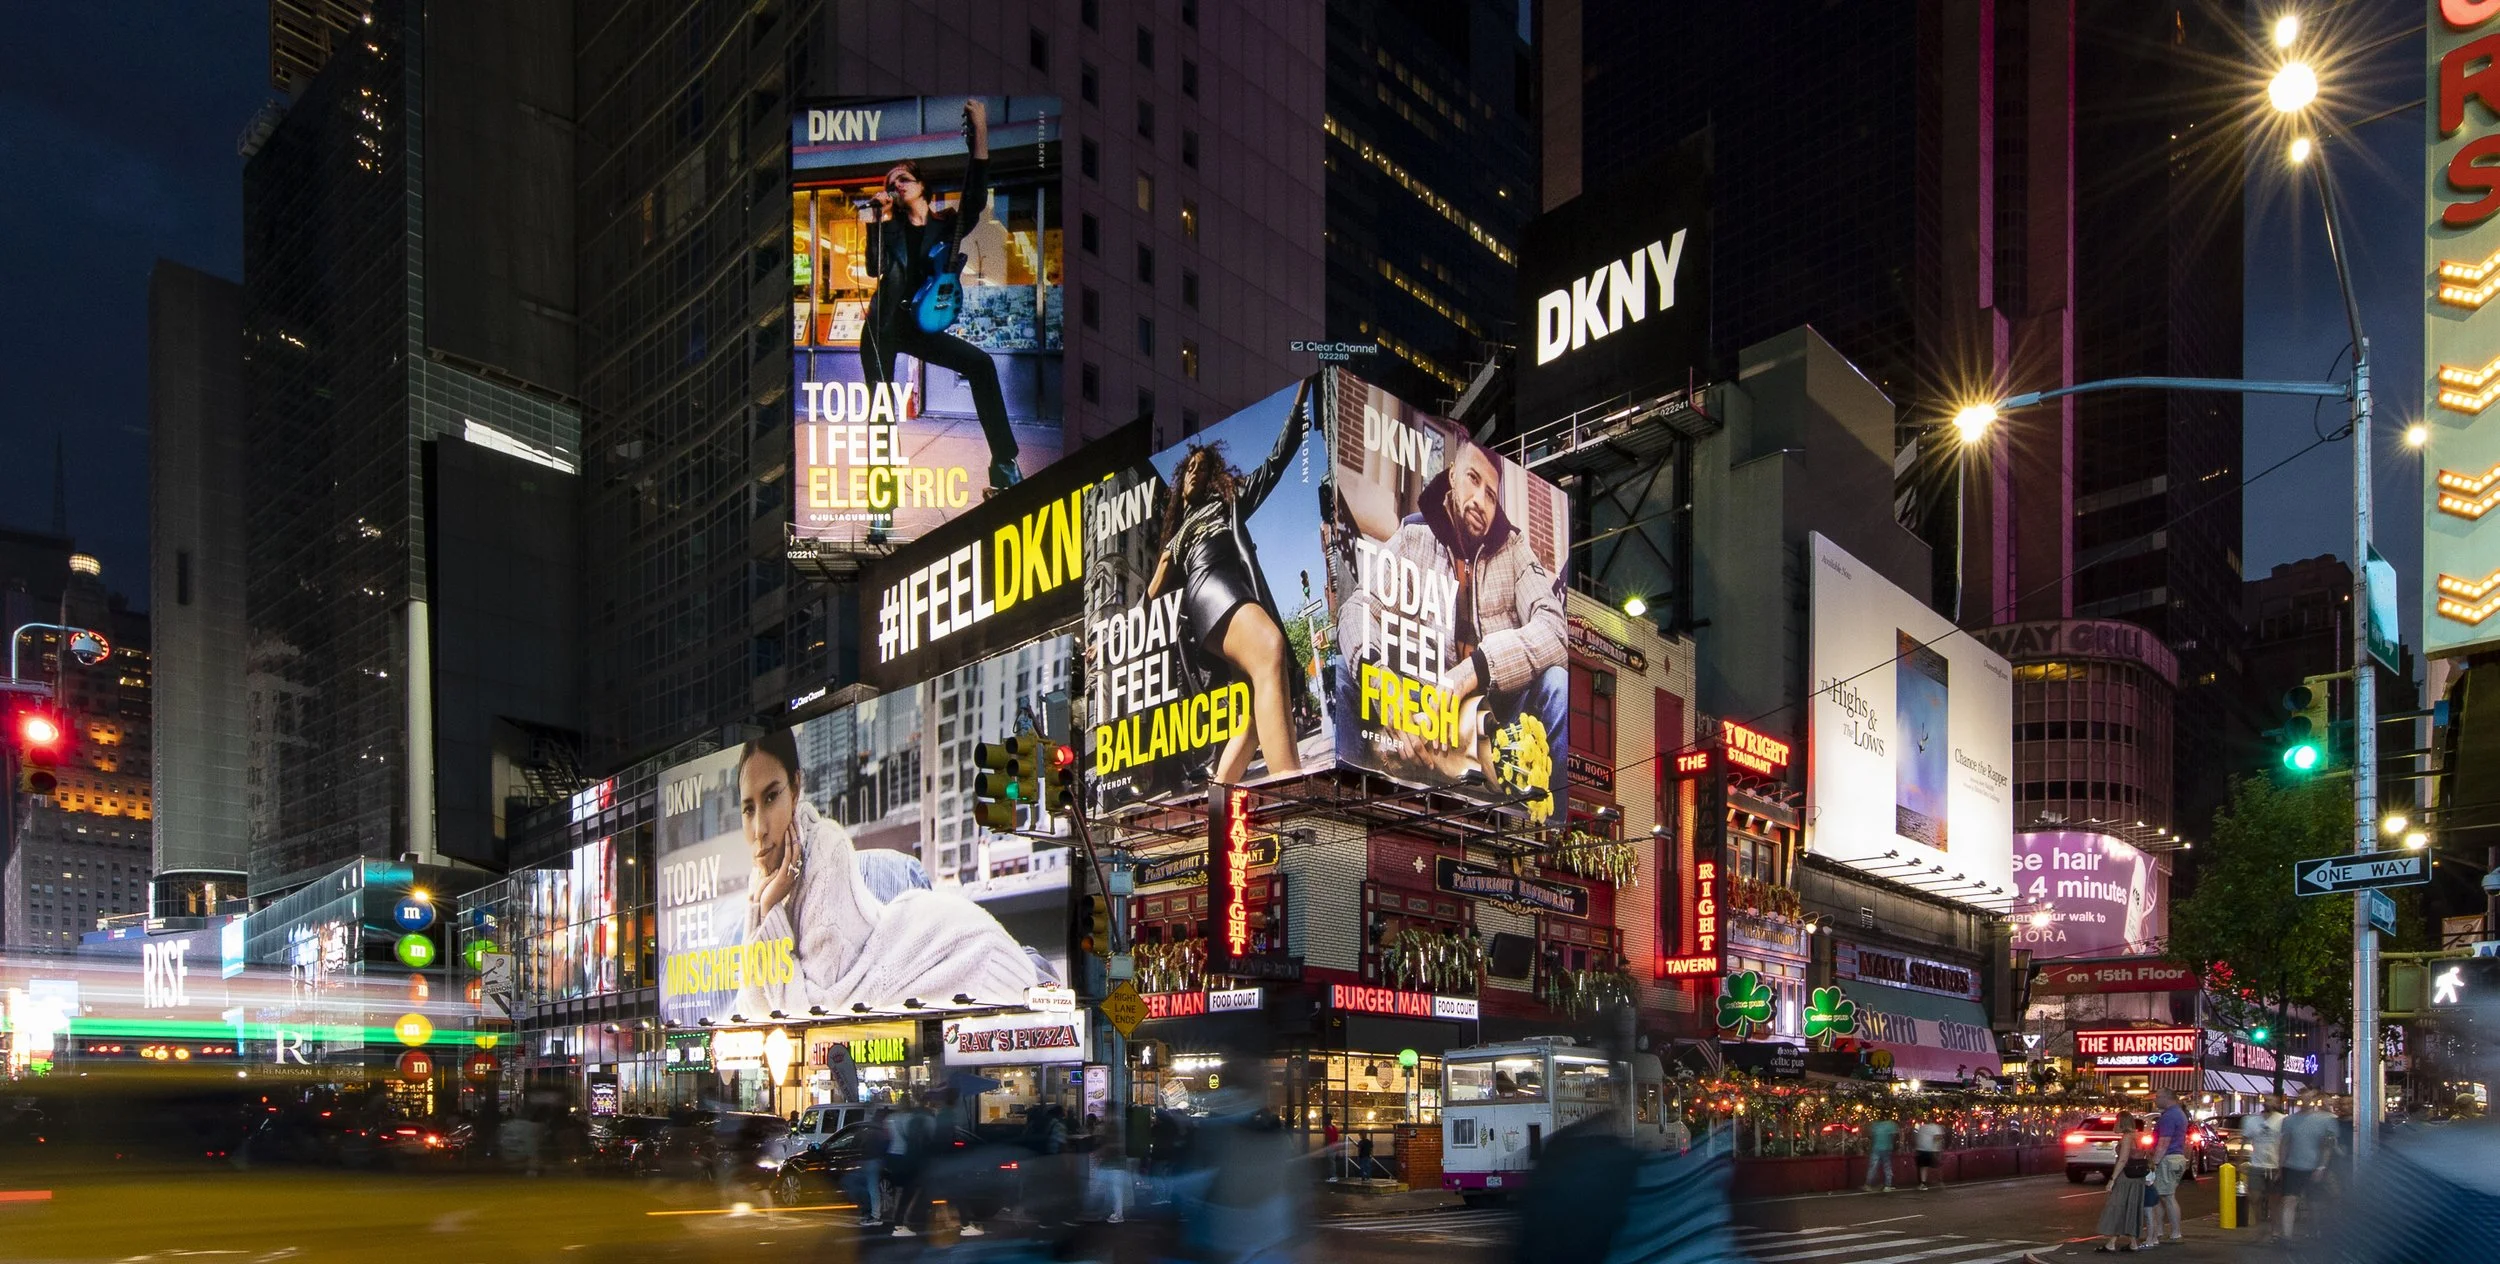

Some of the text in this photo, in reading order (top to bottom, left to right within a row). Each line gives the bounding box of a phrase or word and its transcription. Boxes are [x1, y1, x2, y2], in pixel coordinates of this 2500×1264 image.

[808, 110, 881, 141] DKNY
[1537, 228, 1687, 366] DKNY
[1306, 341, 1377, 353] Clear Channel
[802, 382, 914, 422] TODAY
[1660, 400, 1689, 416] 022241
[809, 425, 909, 465] I FEEL
[1363, 403, 1433, 478] DKNY
[808, 467, 969, 508] ELECTRIC
[1097, 476, 1156, 542] DKNY
[879, 473, 1114, 663] #IFEELDKN
[1357, 538, 1459, 632] TODAY
[1092, 588, 1184, 670] TODAY
[1362, 602, 1454, 689] I FEEL
[2070, 623, 2143, 658] GRILL
[1097, 673, 1104, 723] I
[1111, 650, 1179, 719] FEEL
[1361, 662, 1459, 748] FRESH
[1832, 677, 1868, 718] Highs
[1868, 709, 1878, 732] &
[1096, 681, 1250, 776] BALANCED
[1361, 730, 1405, 750] @FENDER
[1585, 761, 1611, 782] ROOM
[1678, 753, 1707, 772] THE
[1954, 748, 1978, 774] Chance
[1978, 761, 1988, 776] the
[1987, 764, 2008, 788] Rapper
[665, 774, 703, 818] DKNY
[1097, 776, 1132, 792] @YENDRY
[1144, 855, 1200, 882] PLAYWRIGHT
[1229, 789, 1248, 955] PLAYWRIGHT
[2053, 848, 2102, 870] hair
[2316, 860, 2412, 883] ONE WAY
[663, 854, 721, 908] TODAY
[1452, 872, 1576, 913] PLAYWRIGHT RESTAURANT
[2028, 876, 2048, 898] 4
[2058, 876, 2127, 906] minutes
[667, 903, 719, 951] I FEEL
[2069, 912, 2095, 923] walk
[2097, 913, 2106, 924] to
[143, 939, 190, 1008] RISE
[667, 936, 794, 997] MISCHIEVOUS
[1666, 958, 1717, 974] TAVERN
[1859, 951, 1907, 983] MAMA
[2067, 967, 2186, 983] on 15th Floor
[1114, 992, 1136, 1003] RIGHT
[1114, 1004, 1136, 1014] LANE
[1171, 991, 1205, 1016] MAN
[1212, 995, 1231, 1009] FOOD
[1233, 992, 1256, 1006] COURT
[1334, 984, 1475, 1017] BURGER MAN FOOD COURT
[1115, 1015, 1136, 1025] ENDS
[1860, 1003, 1987, 1053] sbarro sbarro
[274, 1030, 312, 1065] R
[849, 1040, 867, 1063] THE
[868, 1038, 905, 1065] SQUARE
[958, 1026, 1075, 1053] RAY'S PIZZA
[2079, 1037, 2108, 1053] THE
[2113, 1035, 2195, 1053] HARRISON
[2233, 1042, 2246, 1067] THE
[1771, 1056, 1804, 1069] celtic pub
[2096, 1054, 2149, 1065] BRASSERIE
[2158, 1052, 2180, 1065] Bar
